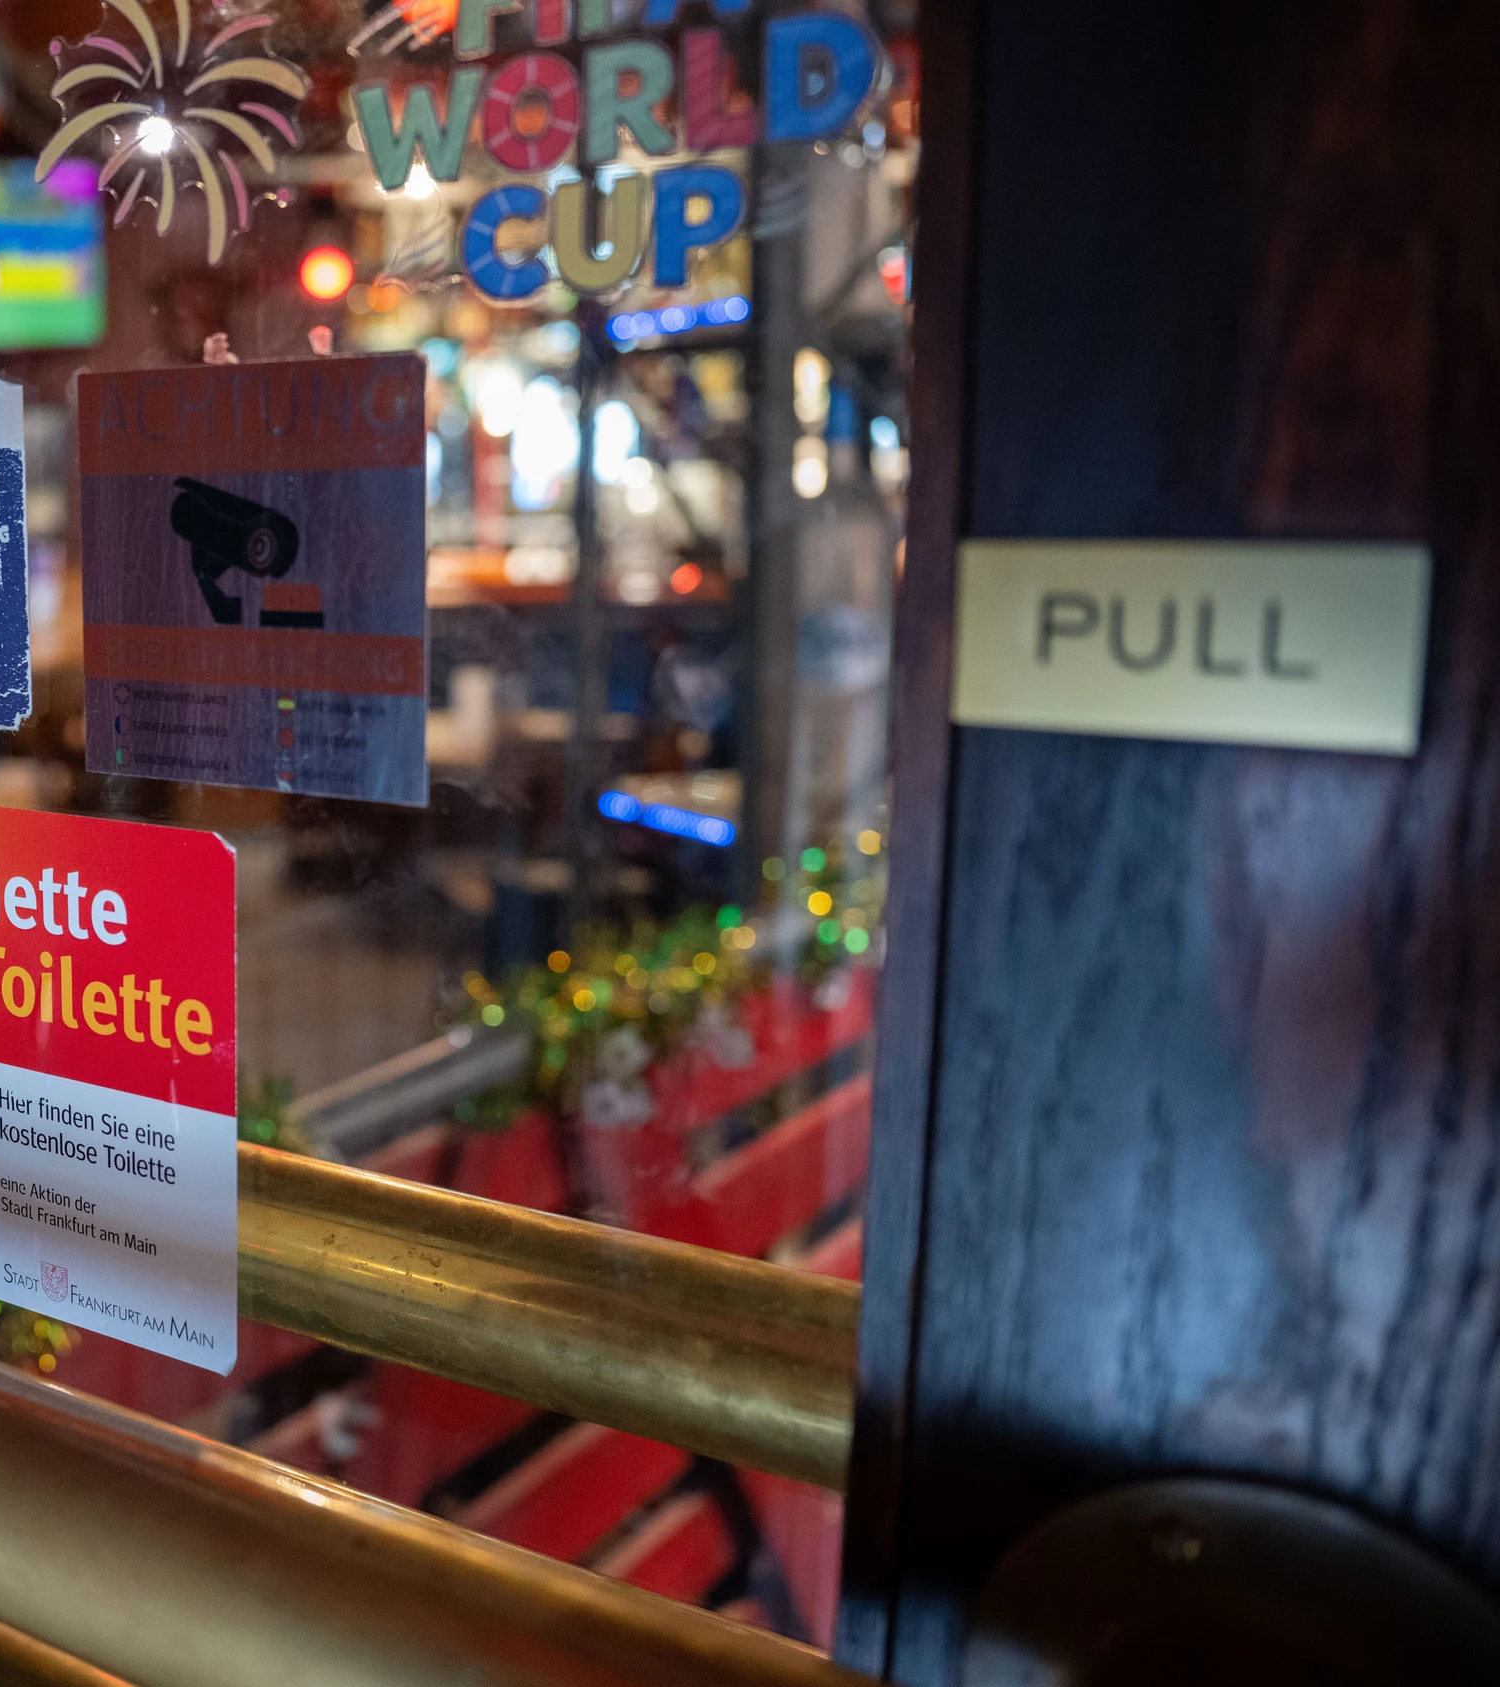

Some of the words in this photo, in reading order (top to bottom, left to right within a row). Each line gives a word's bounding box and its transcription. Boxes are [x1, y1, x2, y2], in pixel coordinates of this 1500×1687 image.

[356, 12, 876, 190] WORLD
[462, 164, 745, 299] CUP
[98, 368, 412, 444] ACHTUNG
[1033, 590, 1320, 682] PULL
[0, 1117, 97, 1164] kostenlose
[103, 1144, 176, 1185] Toilette
[39, 1097, 94, 1131] finden
[101, 1113, 128, 1140] Sie
[135, 1124, 175, 1151] eine
[0, 1177, 26, 1195] eine
[30, 1183, 71, 1208] Aktion
[75, 1196, 96, 1215] der
[37, 1207, 96, 1239] Frankfurt
[100, 1229, 120, 1245] am
[124, 1233, 157, 1256] Main
[3, 1263, 39, 1292] STADT
[70, 1284, 141, 1325] FRANKFURT
[143, 1315, 165, 1334] AM
[169, 1316, 214, 1349] MAIN
